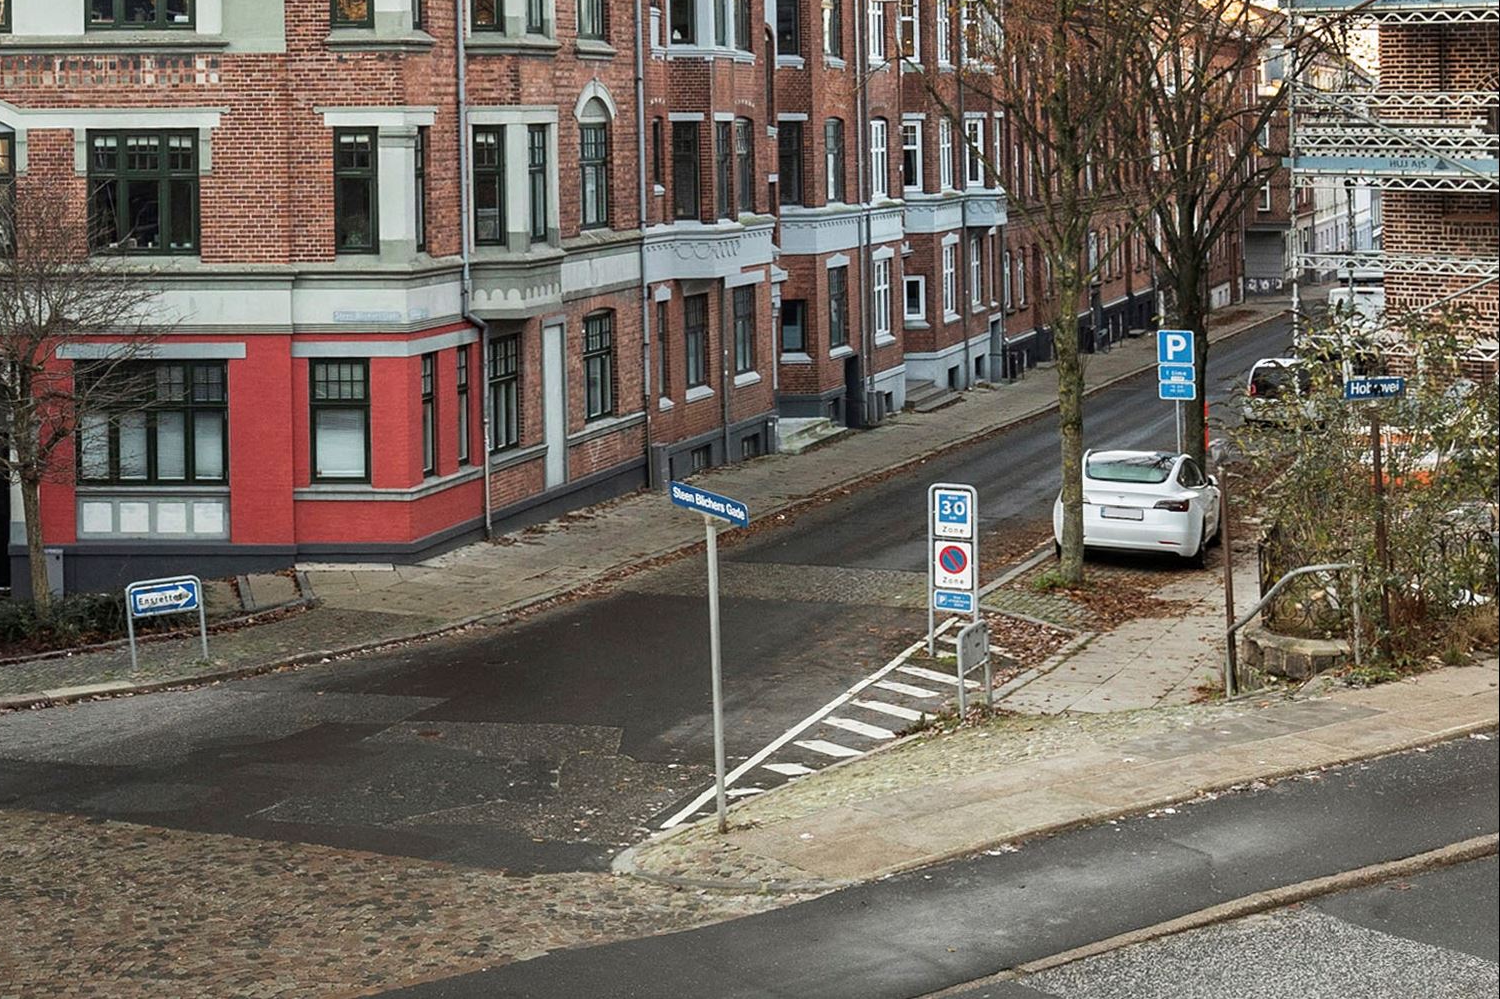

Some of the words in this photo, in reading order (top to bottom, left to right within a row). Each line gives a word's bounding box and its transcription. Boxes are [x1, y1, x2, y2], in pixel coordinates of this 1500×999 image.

[1389, 160, 1409, 169] HUJ
[1167, 334, 1187, 360] P
[672, 486, 695, 503] Steen
[695, 492, 726, 514] Blichers
[725, 503, 746, 520] Gade
[941, 500, 966, 516] 30
[942, 525, 965, 534] Zone
[943, 576, 964, 585] Zone
